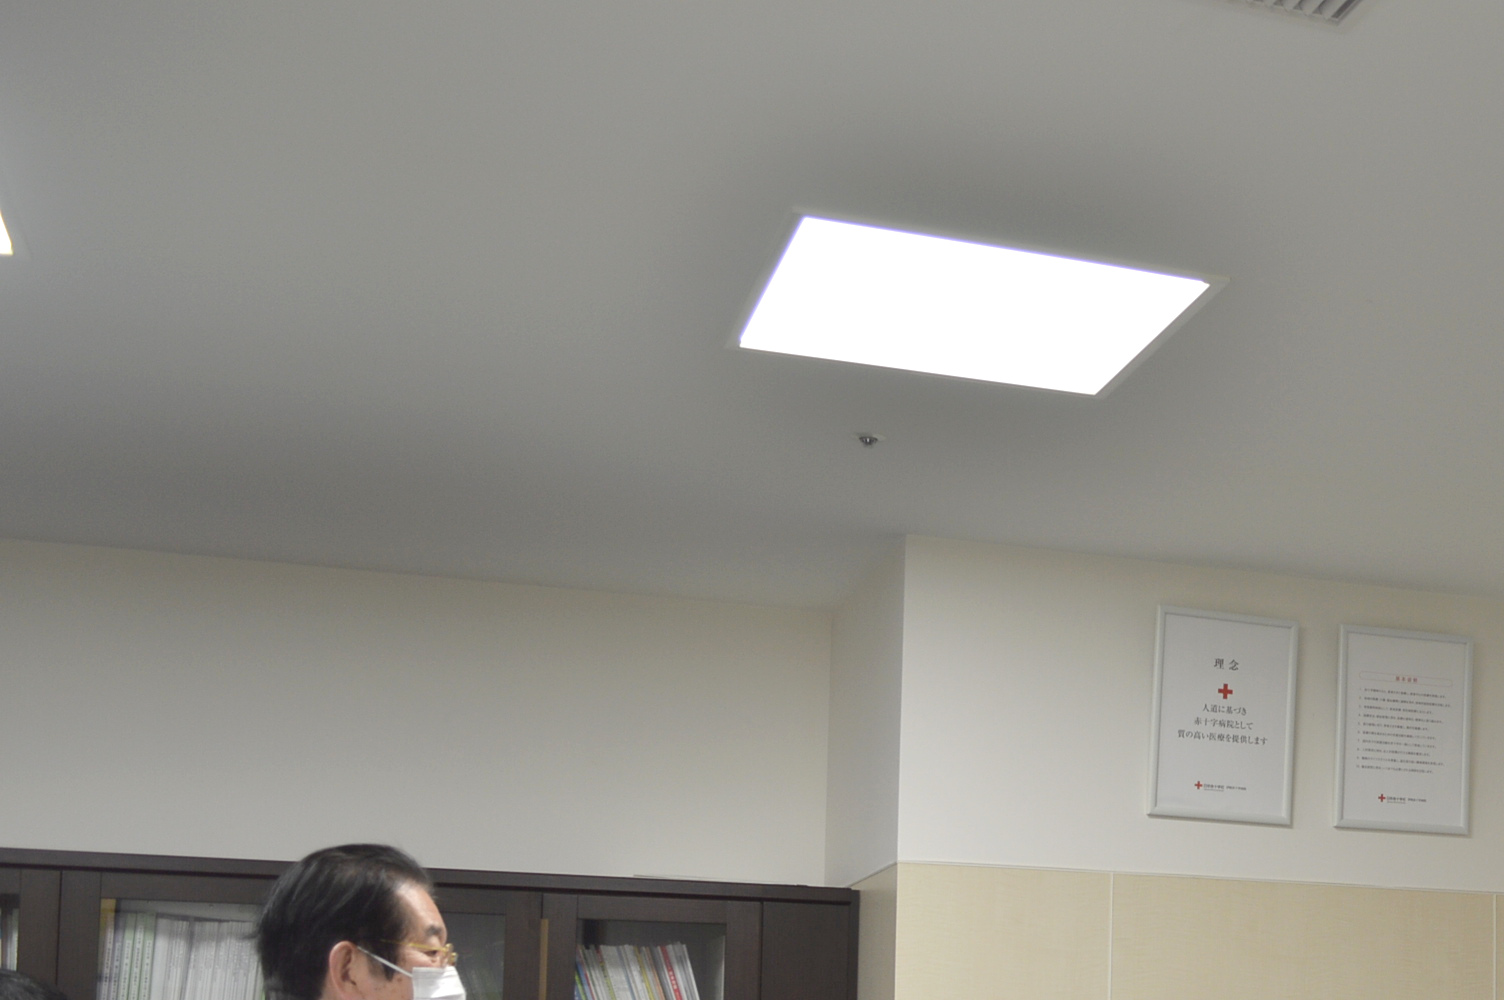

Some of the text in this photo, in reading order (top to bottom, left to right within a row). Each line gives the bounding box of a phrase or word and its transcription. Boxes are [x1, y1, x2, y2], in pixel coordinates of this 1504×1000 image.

[1214, 658, 1239, 671] 理念
[1202, 703, 1247, 716] 人道に基づき
[1194, 716, 1254, 730] 赤十字病院として
[1177, 729, 1268, 745] 質の高い医療を提供します
